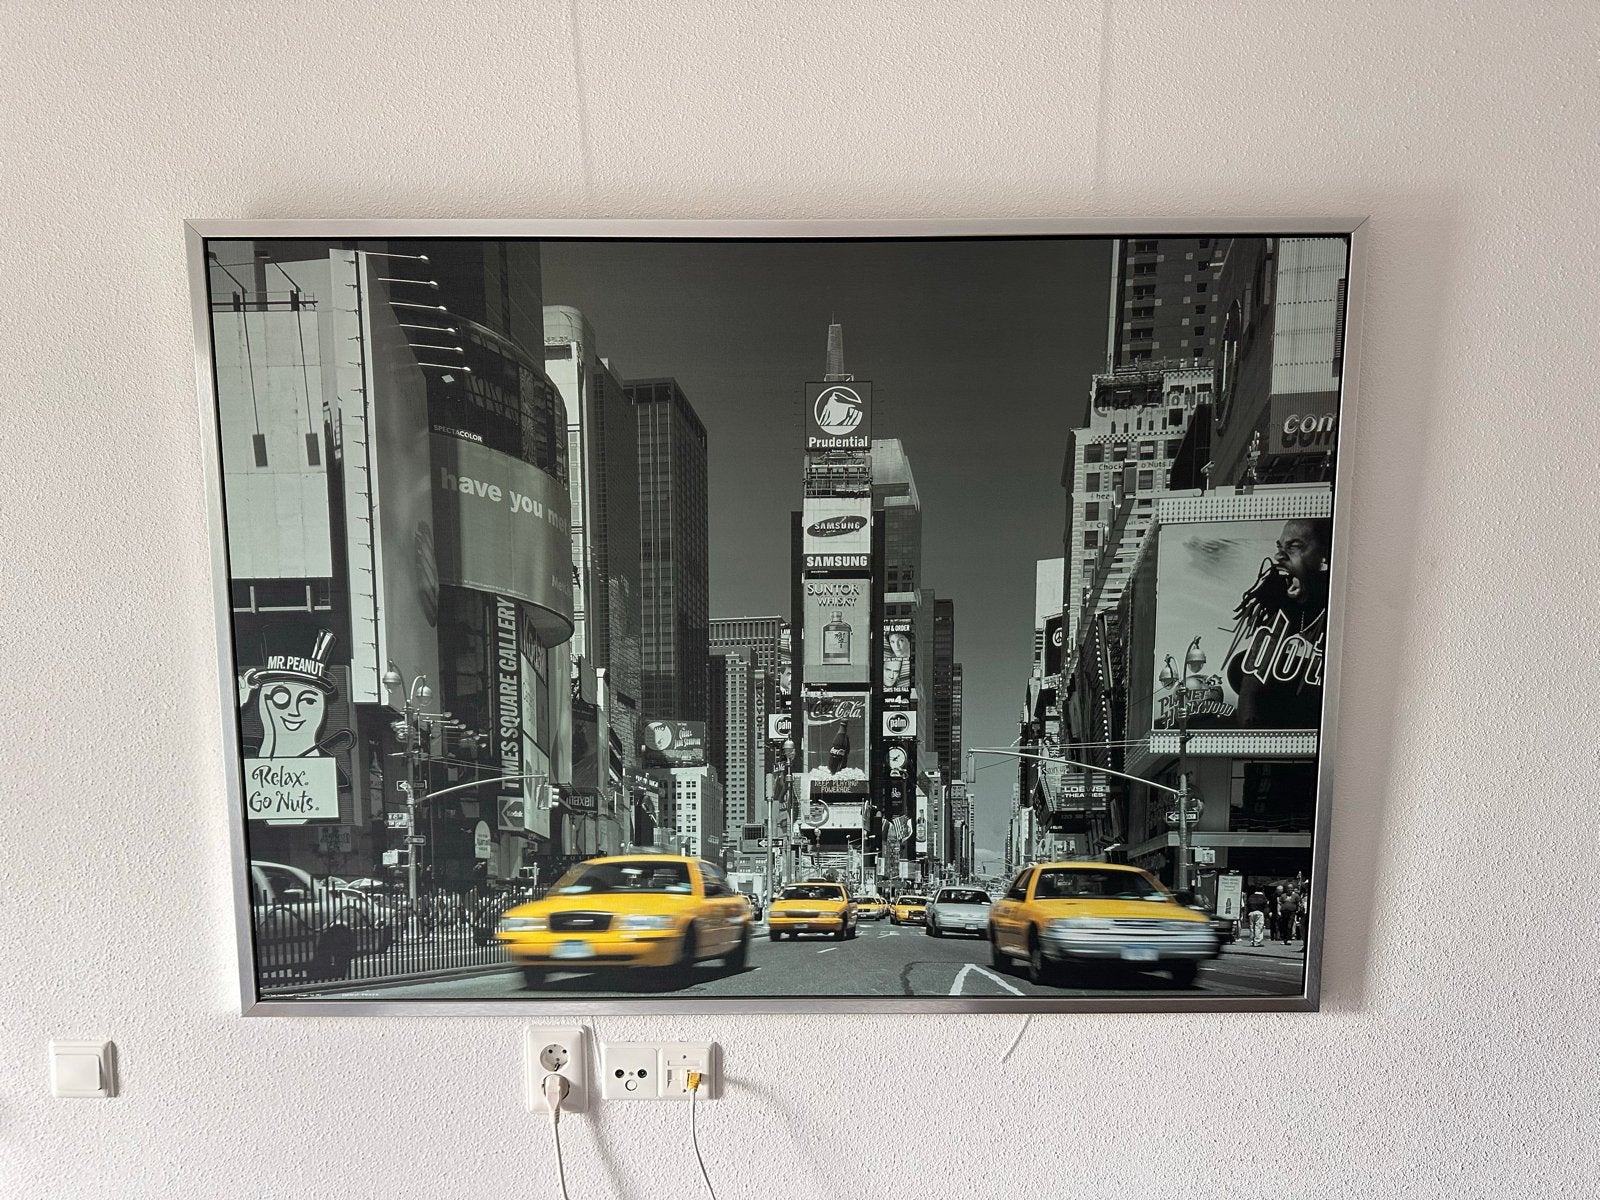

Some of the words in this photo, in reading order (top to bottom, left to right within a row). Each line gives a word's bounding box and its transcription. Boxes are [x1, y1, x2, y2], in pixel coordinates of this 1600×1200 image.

[433, 424, 482, 442] SPECTACOLOR
[808, 435, 868, 448] Prudential
[440, 466, 502, 502] have
[509, 490, 543, 519] you
[814, 521, 860, 530] SAMSUNG
[806, 555, 868, 567] SAMSUNG
[807, 583, 866, 596] SUNTOR
[496, 596, 517, 672] GALLERY
[267, 655, 286, 670] MR.
[287, 656, 324, 677] PEANUT
[500, 673, 520, 739] SQUARE
[1158, 689, 1212, 718] PLNET
[890, 717, 907, 728] palm
[252, 765, 309, 788] Relax.
[501, 741, 520, 790] TIMES
[249, 791, 272, 812] Go
[275, 790, 320, 813] Nuts.
[565, 795, 595, 808] maxell
